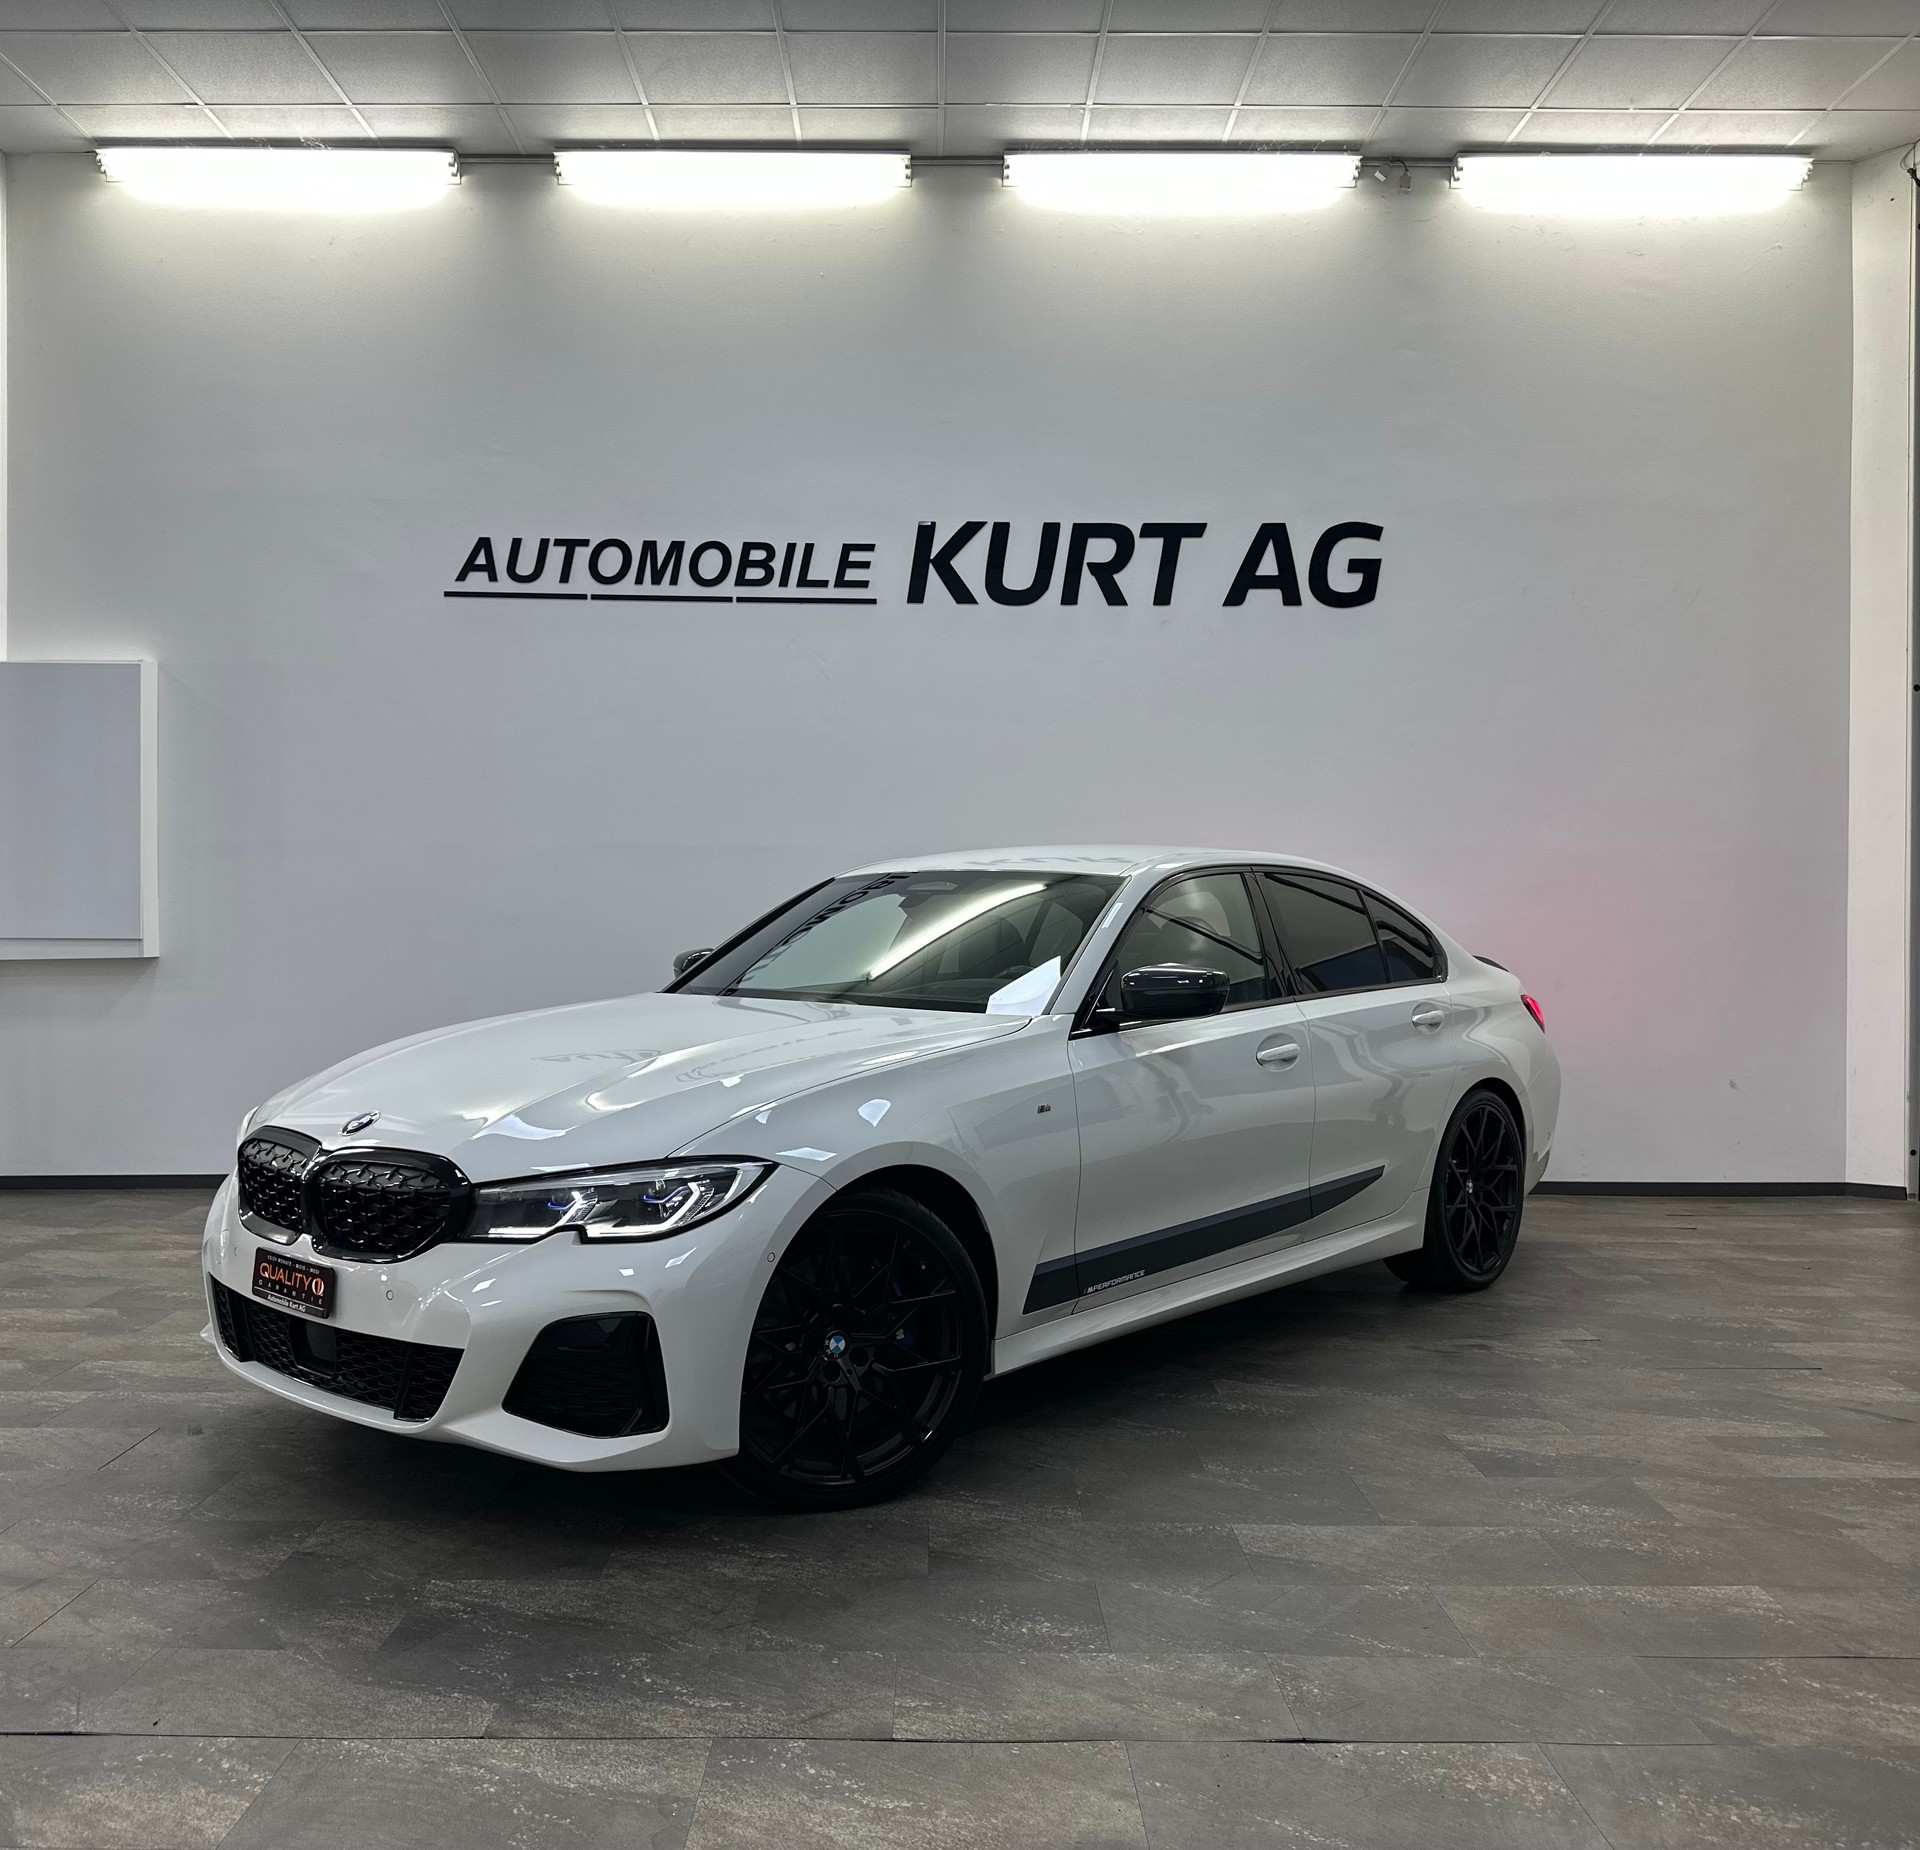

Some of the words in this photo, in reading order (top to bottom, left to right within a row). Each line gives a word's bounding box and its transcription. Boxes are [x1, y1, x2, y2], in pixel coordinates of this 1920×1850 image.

[454, 536, 877, 589] AUTOMOBILE
[906, 521, 1208, 607] KURT
[1221, 521, 1384, 609] AG
[259, 1262, 312, 1290] QUALITY
[1093, 1269, 1146, 1291] PERFORMANCE
[258, 1279, 323, 1305] GARANTIE
[267, 1294, 289, 1307] Automobile
[289, 1301, 299, 1310] Kurt
[299, 1304, 307, 1313] AG
